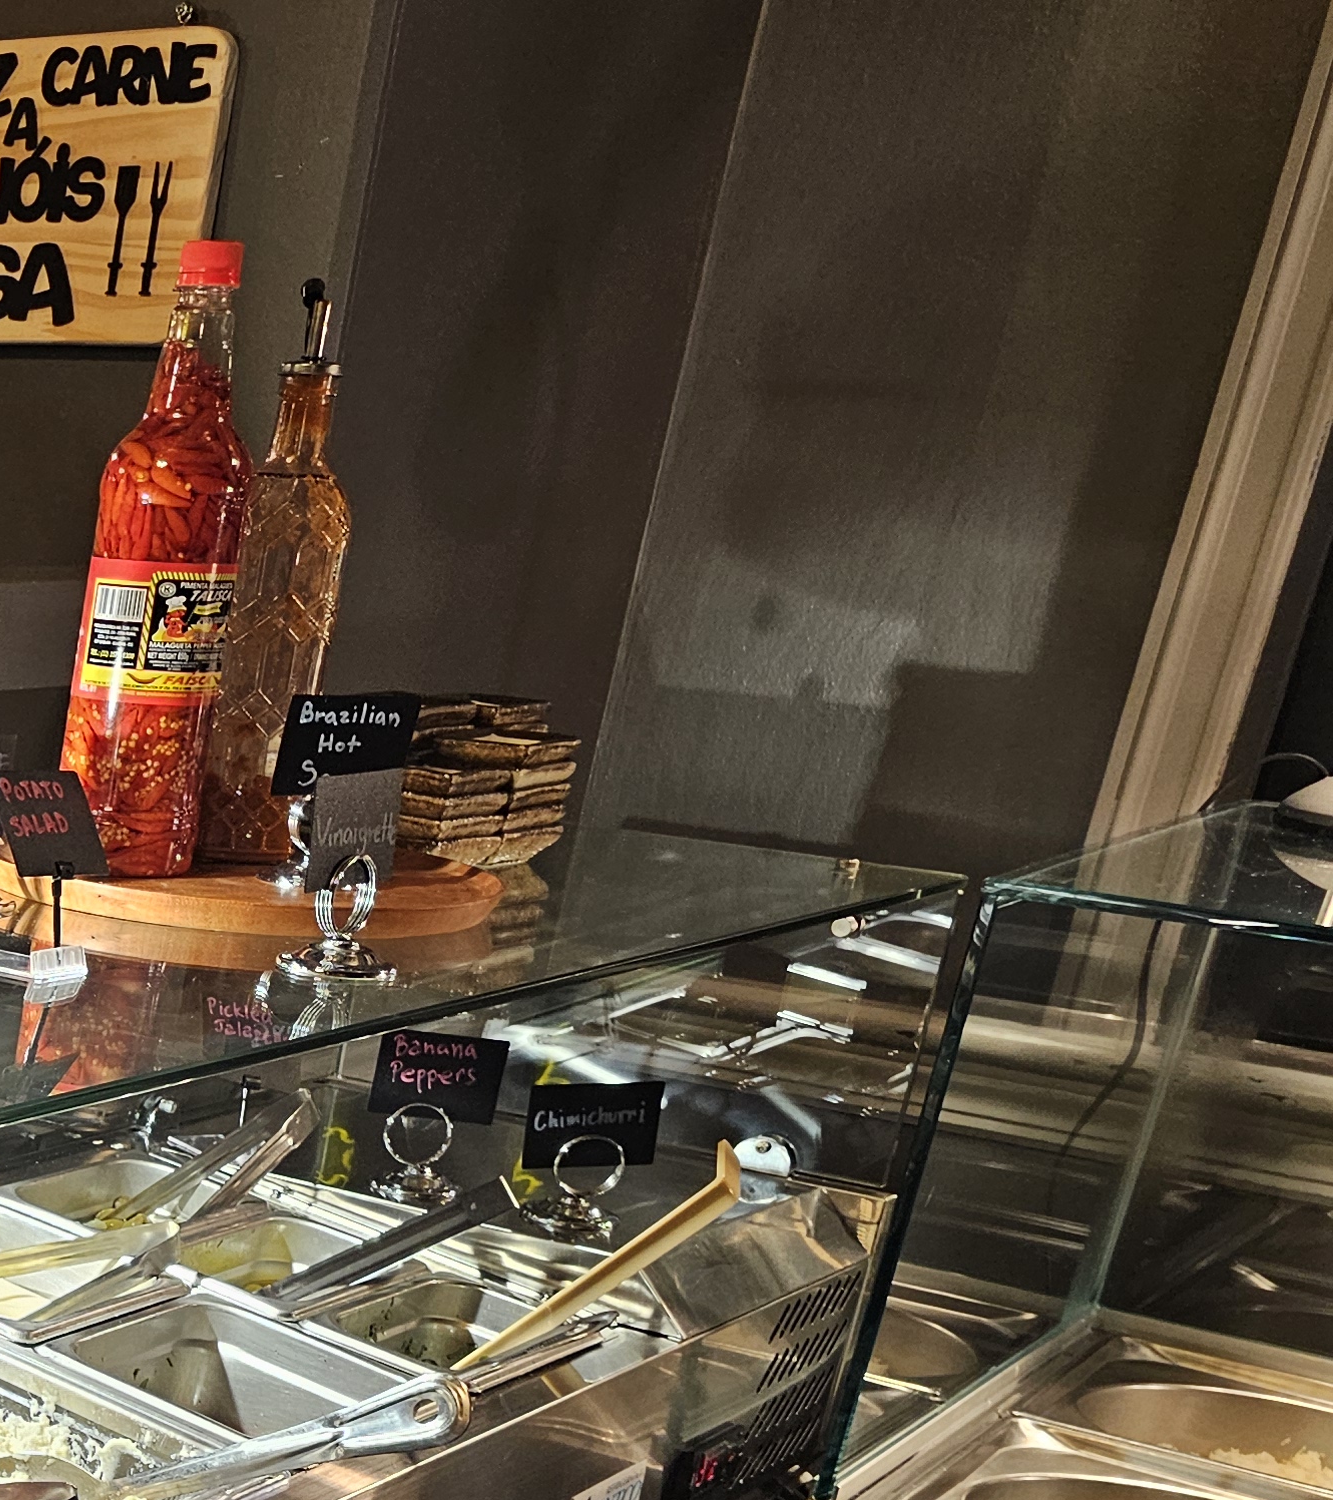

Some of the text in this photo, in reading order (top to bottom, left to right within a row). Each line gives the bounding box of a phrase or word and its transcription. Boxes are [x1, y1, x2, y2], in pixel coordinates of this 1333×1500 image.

[41, 42, 218, 107] CARNE
[3, 97, 39, 151] A
[299, 700, 402, 728] Brazilian
[317, 732, 362, 754] Hot
[8, 810, 70, 838] SALAD
[393, 1033, 478, 1060] Banana
[389, 1059, 477, 1094] Peppers
[533, 1100, 646, 1132] Chimichurri
